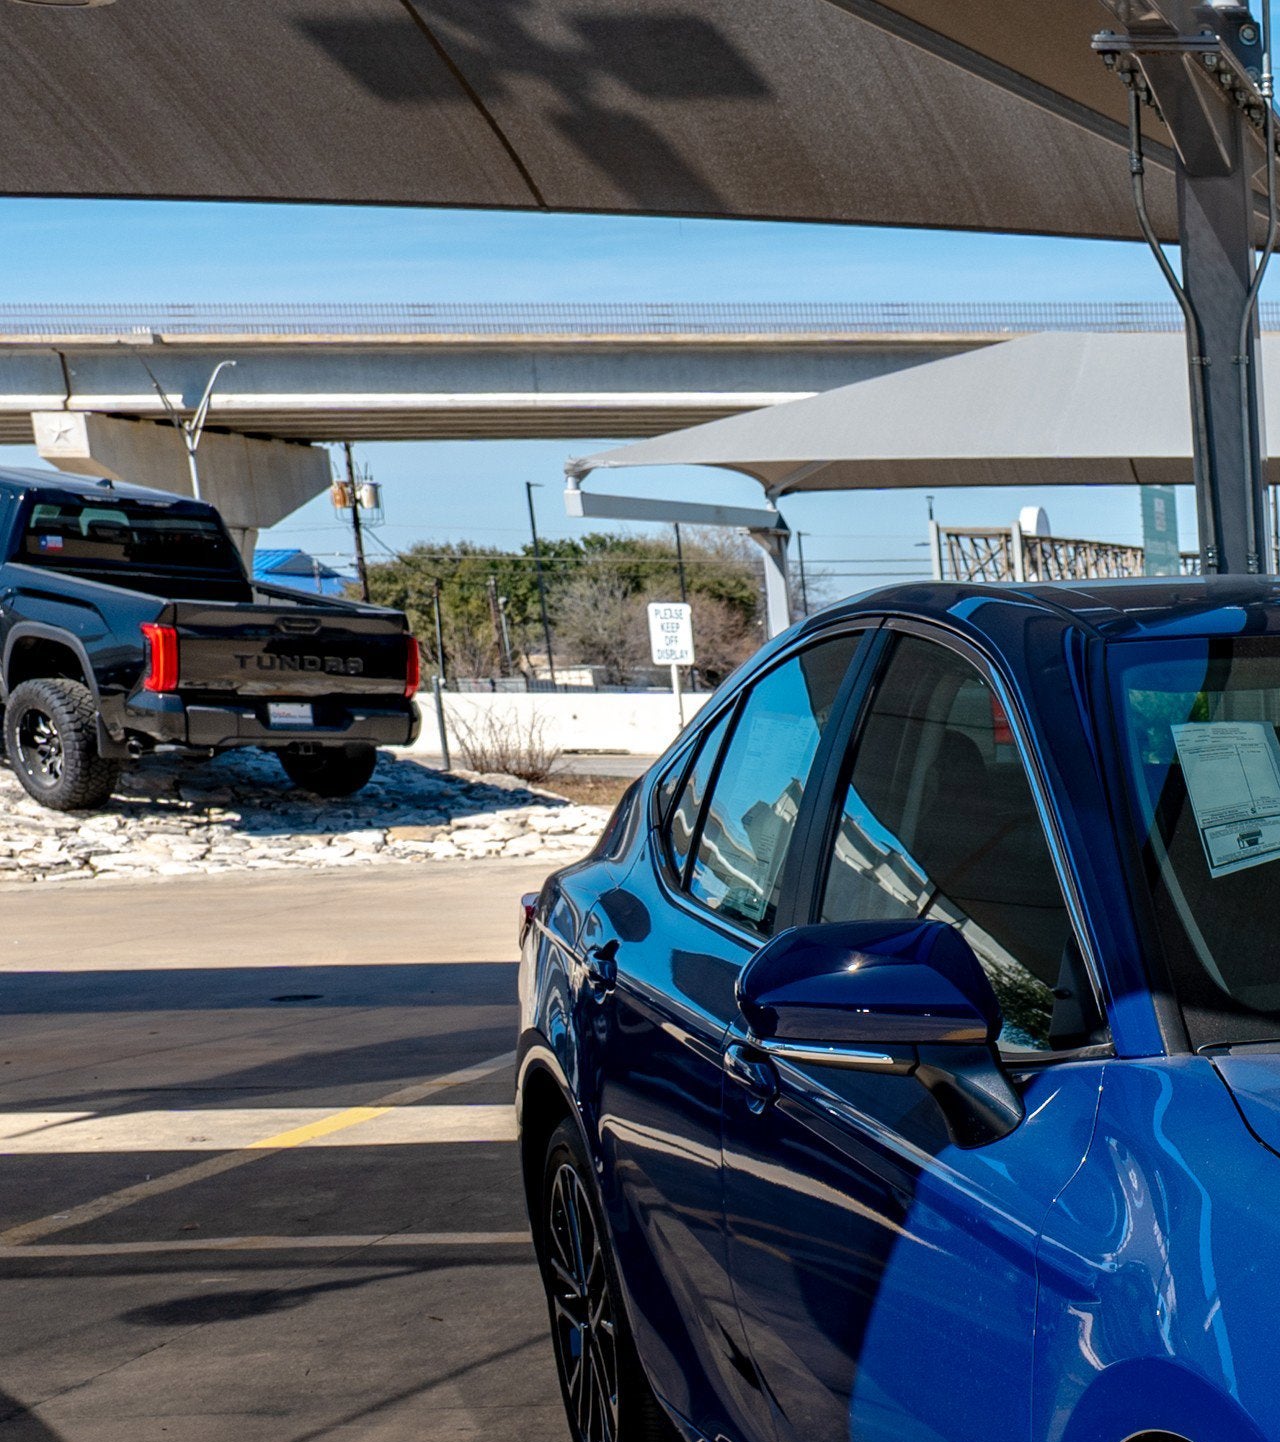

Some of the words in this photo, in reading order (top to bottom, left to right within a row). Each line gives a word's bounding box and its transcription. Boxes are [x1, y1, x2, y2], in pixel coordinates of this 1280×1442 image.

[660, 622, 680, 633] KEEP
[664, 635, 679, 646] OFF
[657, 648, 688, 660] DISPLAY
[234, 654, 364, 674] TUNDRA
